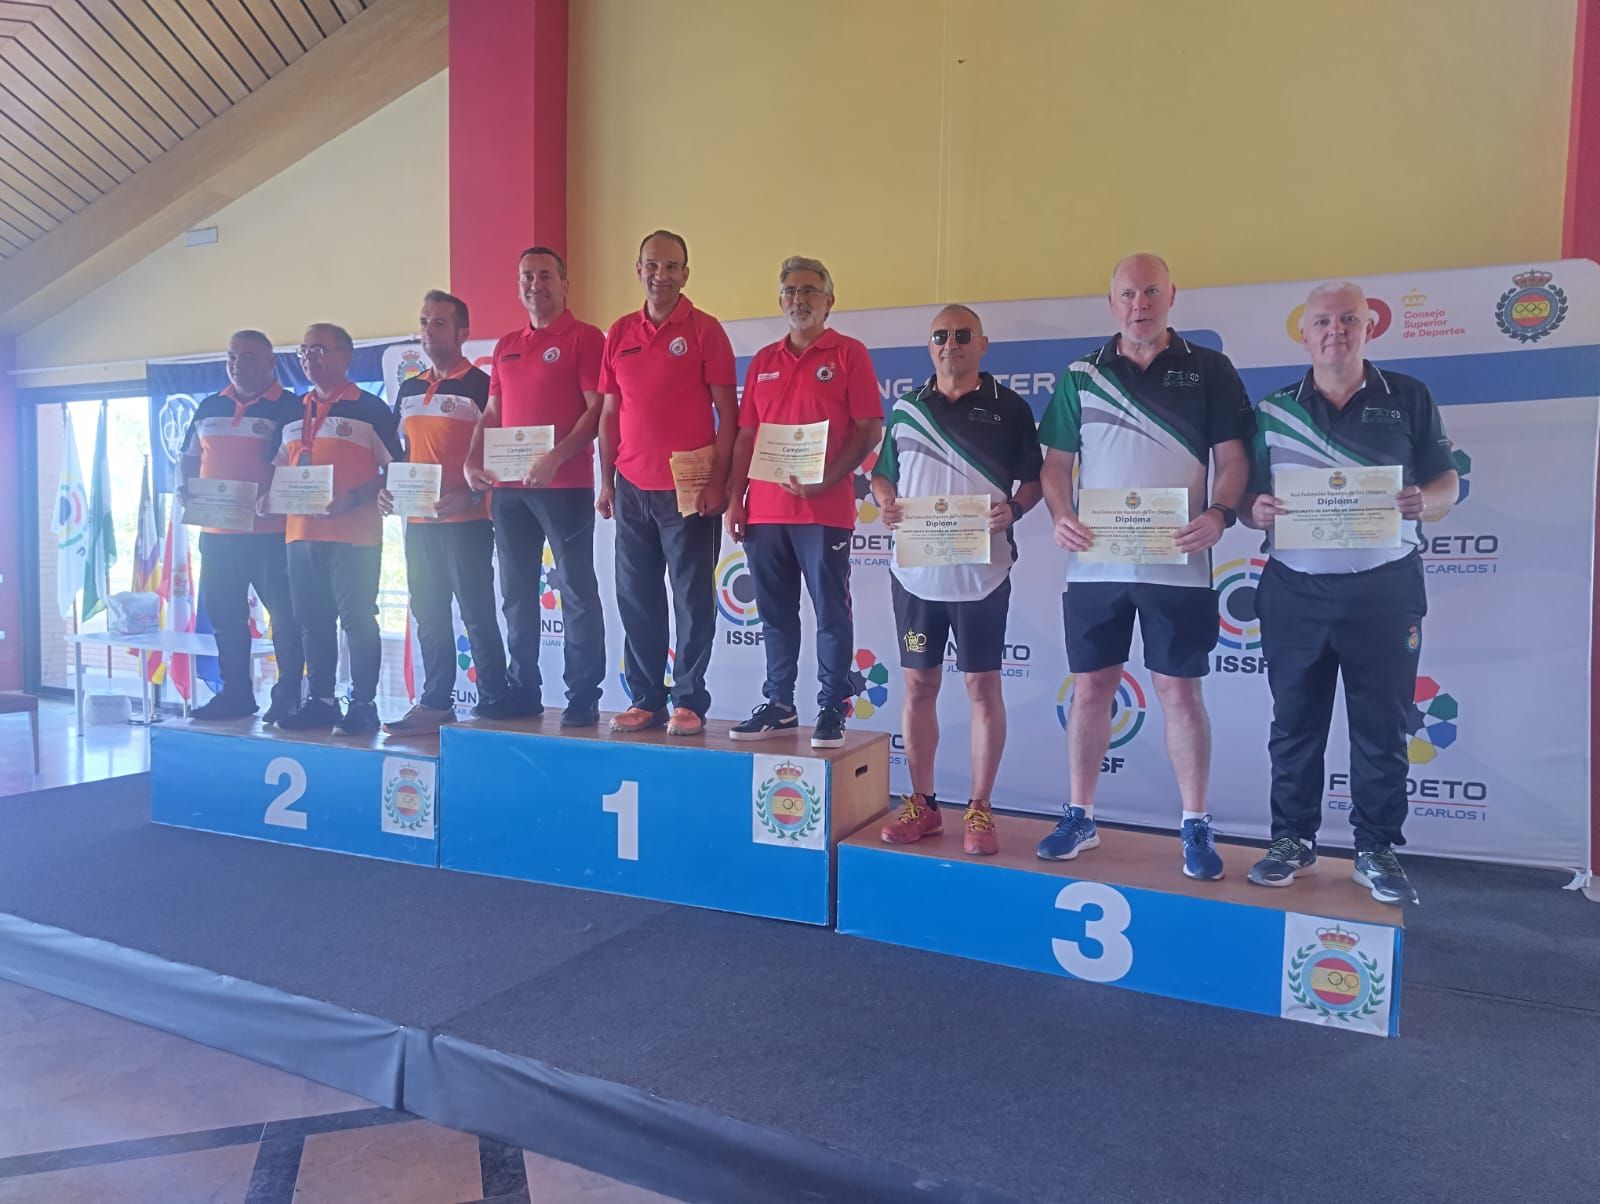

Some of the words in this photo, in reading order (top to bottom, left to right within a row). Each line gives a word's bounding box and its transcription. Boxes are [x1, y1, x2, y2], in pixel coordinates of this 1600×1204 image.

[1404, 309, 1445, 319] Consejo
[1404, 318, 1448, 329] Superior
[1403, 330, 1416, 338] de
[1418, 327, 1466, 338] Deportes
[1317, 497, 1359, 507] Diploma
[926, 520, 957, 528] Diploma
[1115, 516, 1151, 524] Diploma
[1425, 564, 1488, 574] CARLOS
[1493, 564, 1497, 573] I
[726, 631, 764, 646] ISSF
[1215, 655, 1269, 674] ISSF
[264, 756, 308, 831] 2
[1414, 807, 1477, 820] CARLOS
[602, 780, 639, 861] 1
[1051, 881, 1133, 982] 3
